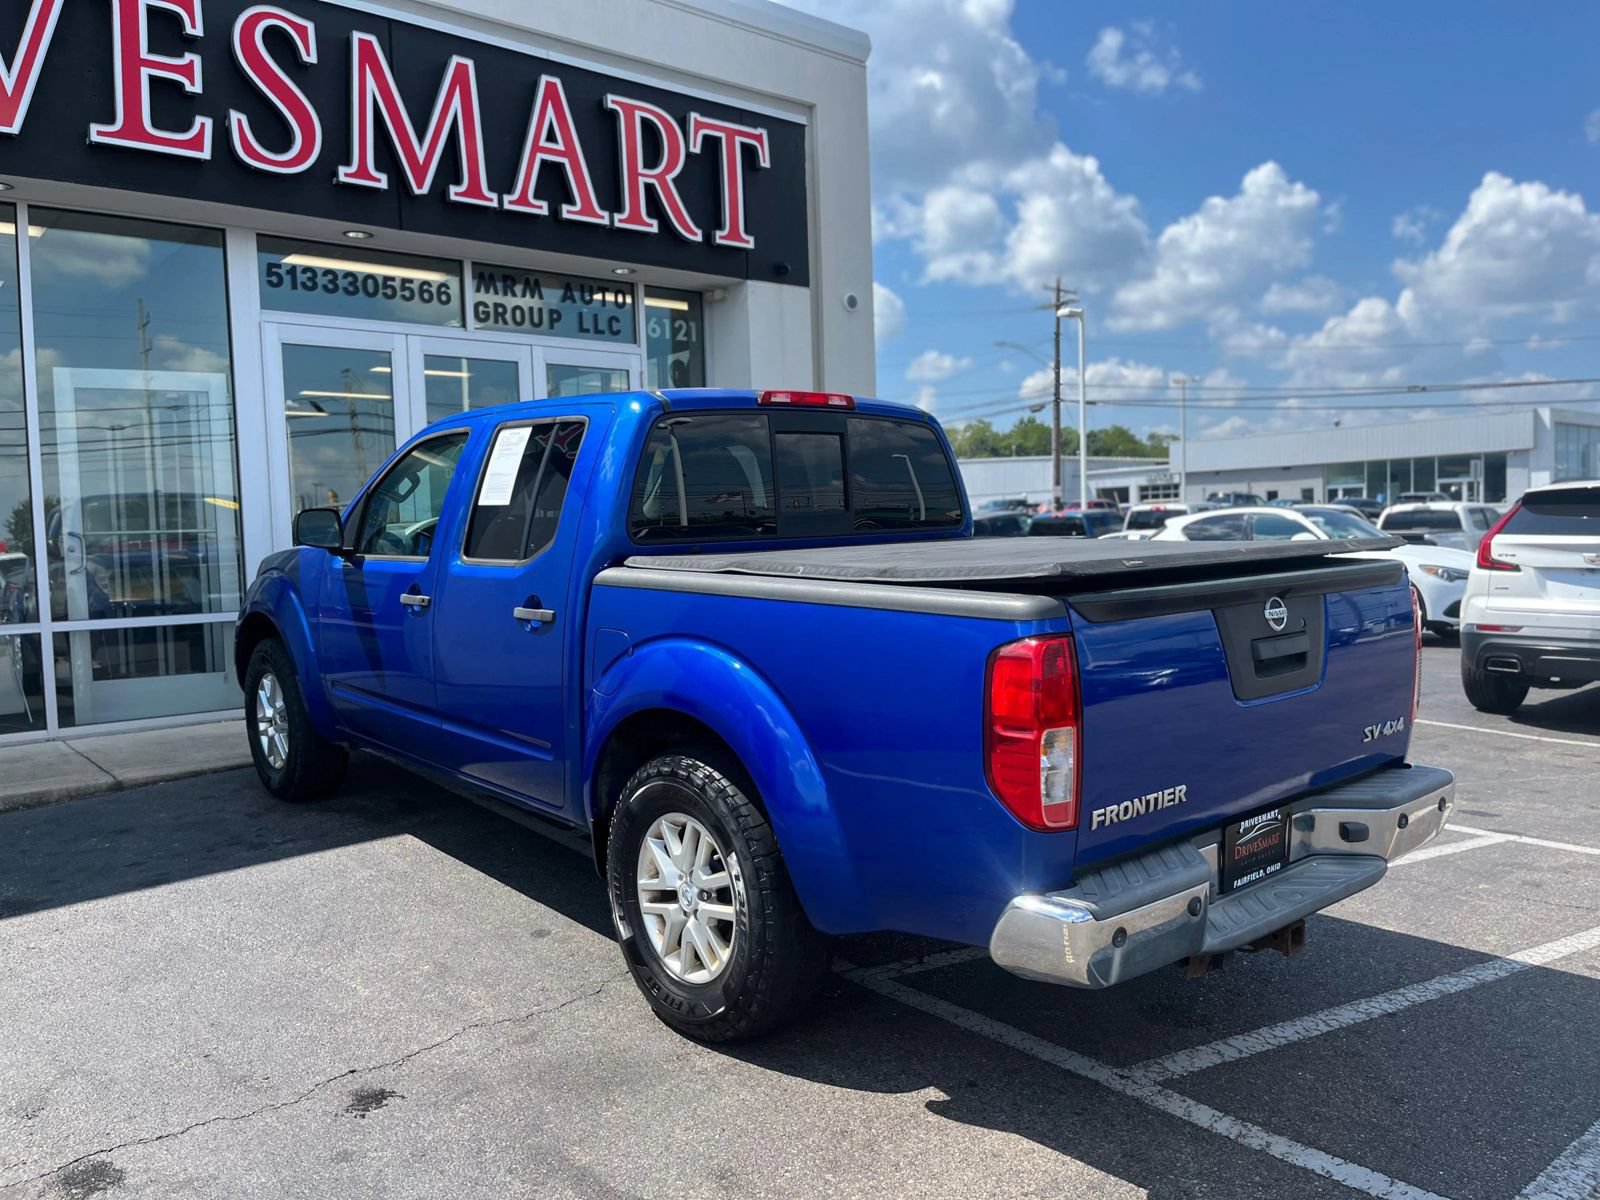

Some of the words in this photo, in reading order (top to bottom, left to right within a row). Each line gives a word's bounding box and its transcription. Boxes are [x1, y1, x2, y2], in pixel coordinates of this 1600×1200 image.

[266, 262, 452, 305] 5133305566
[475, 271, 544, 300] MRM
[561, 282, 627, 309] AUTO
[473, 301, 562, 329] GROUP
[578, 311, 622, 336] LLC
[647, 317, 697, 342] 6121
[1363, 723, 1381, 743] SV
[1091, 784, 1188, 831] FRONTIER
[1240, 808, 1279, 829] DRIVESMART
[1266, 862, 1281, 875] OHIO
